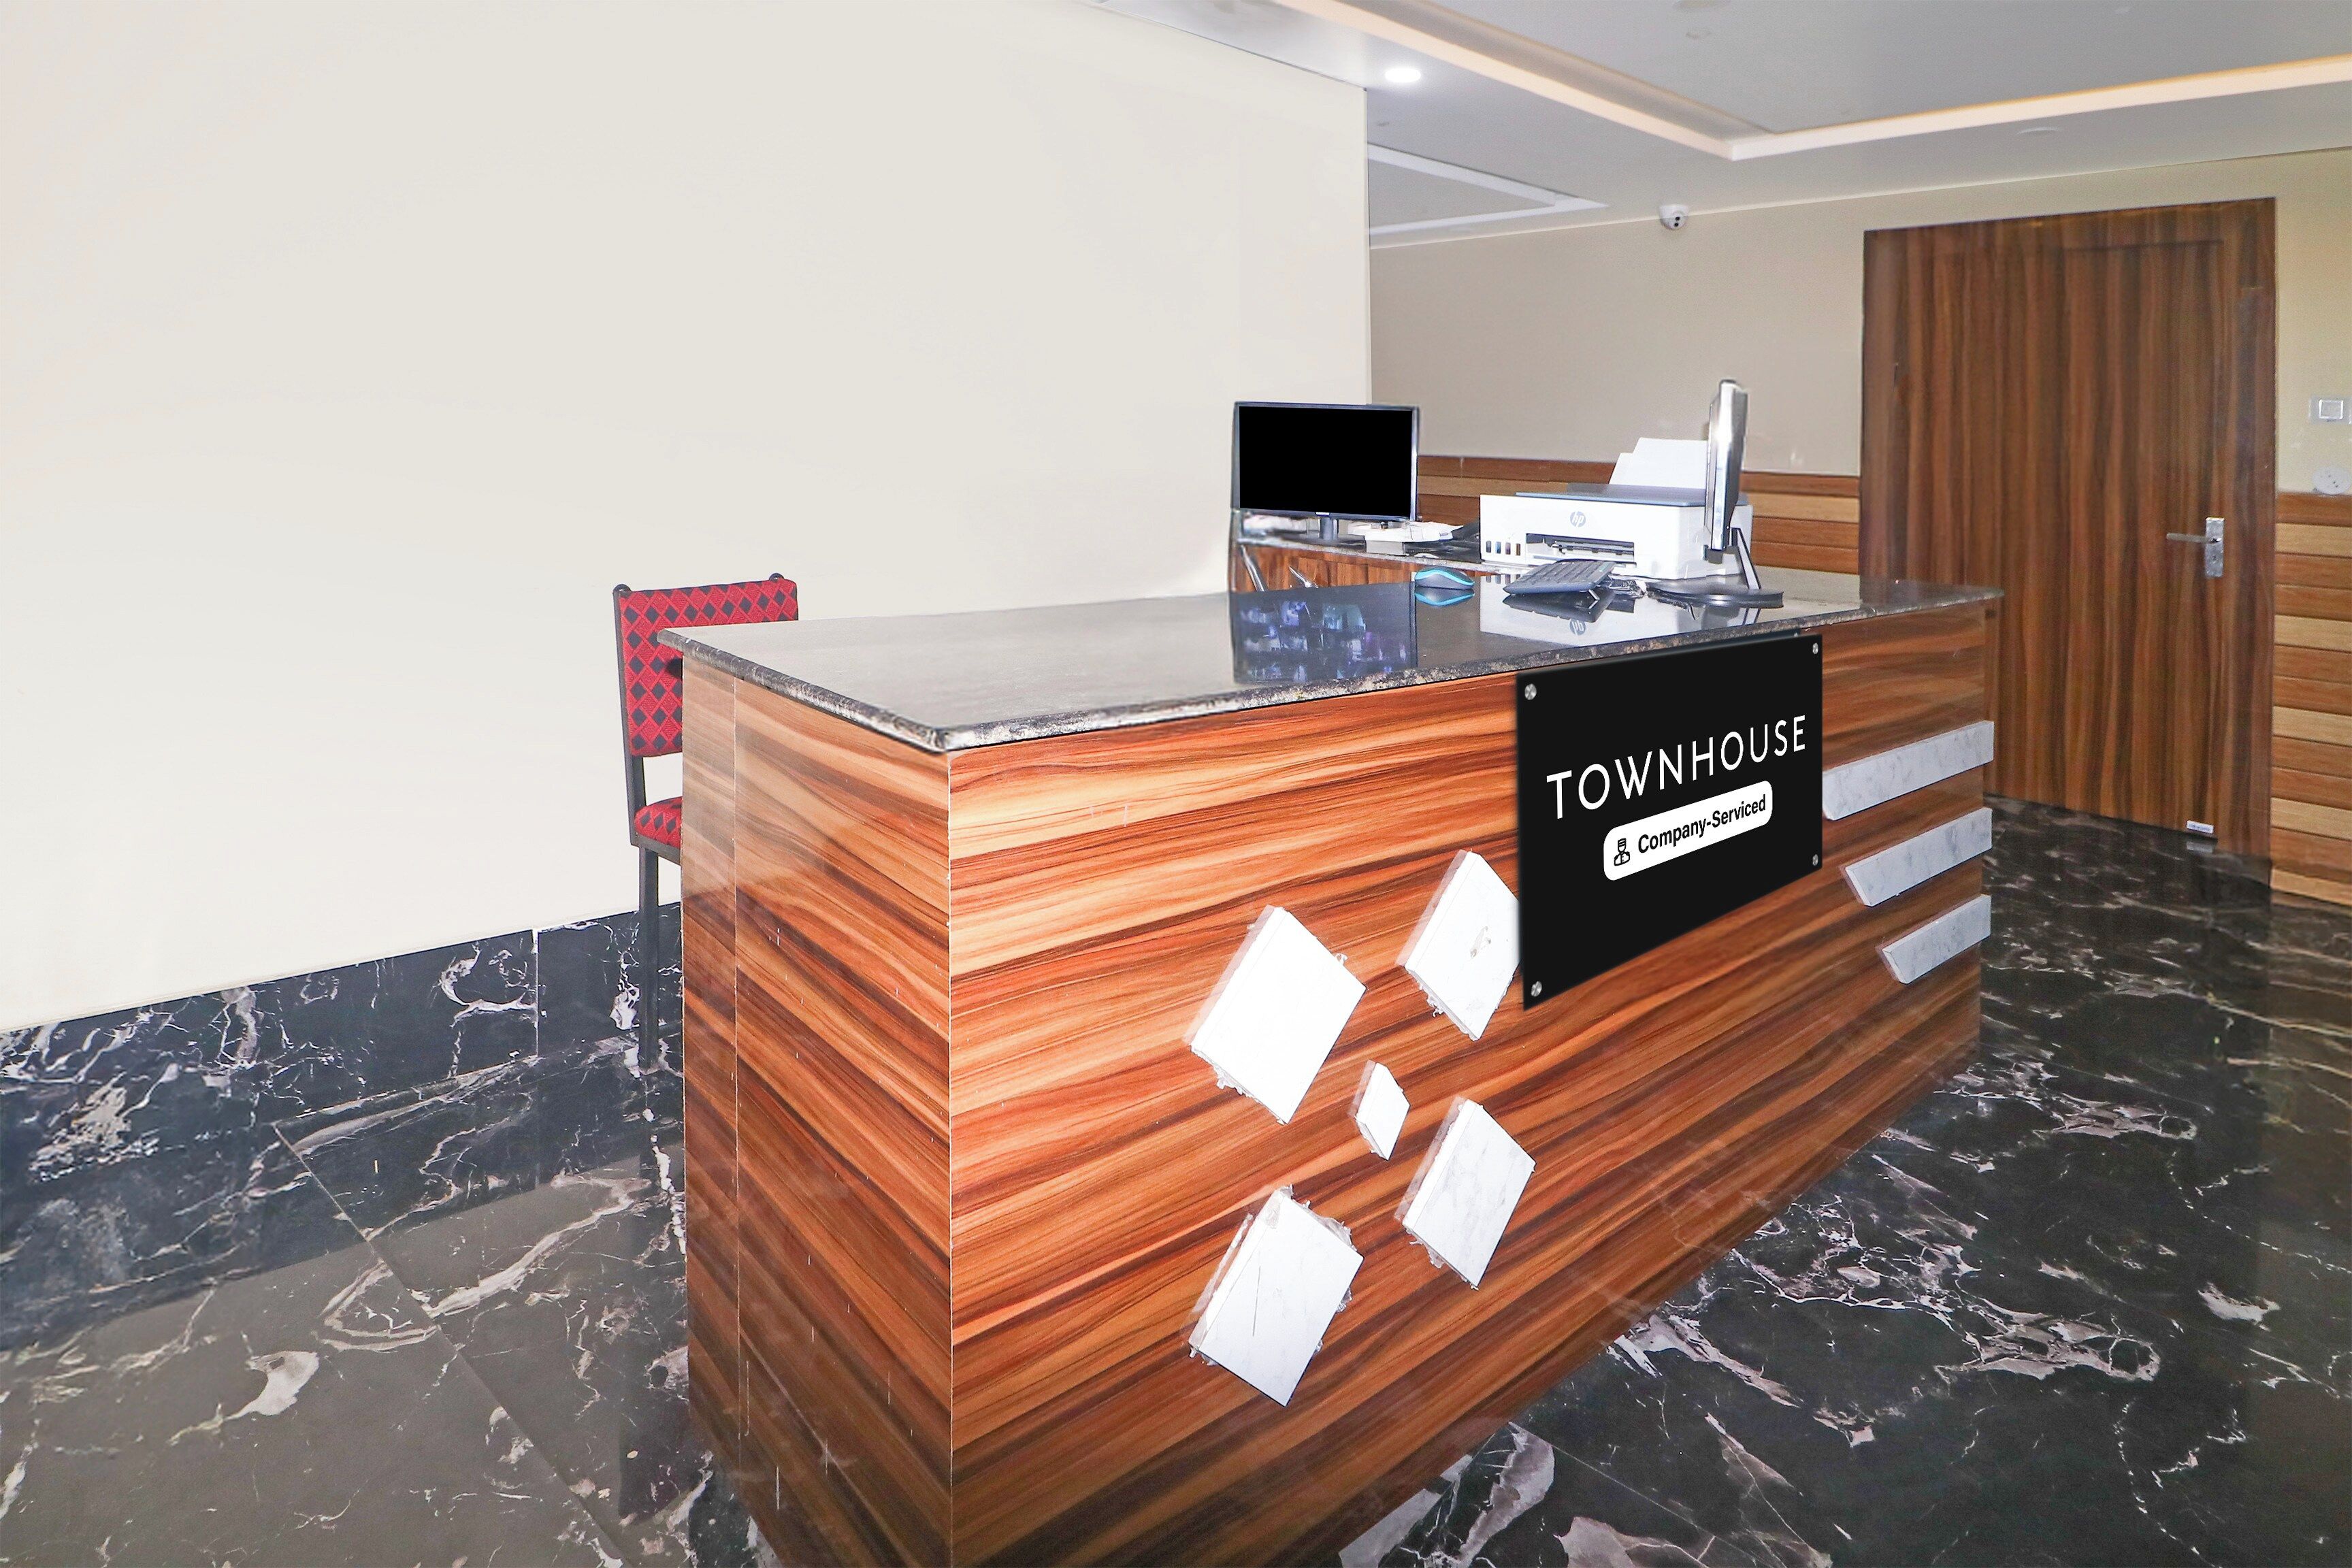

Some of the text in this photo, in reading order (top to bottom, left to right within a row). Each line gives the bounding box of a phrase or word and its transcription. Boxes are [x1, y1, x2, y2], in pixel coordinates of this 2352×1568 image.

[1570, 511, 1586, 527] hp
[1547, 715, 1806, 819] TOWNHOUSE
[1638, 794, 1766, 853] Company-Serviced
